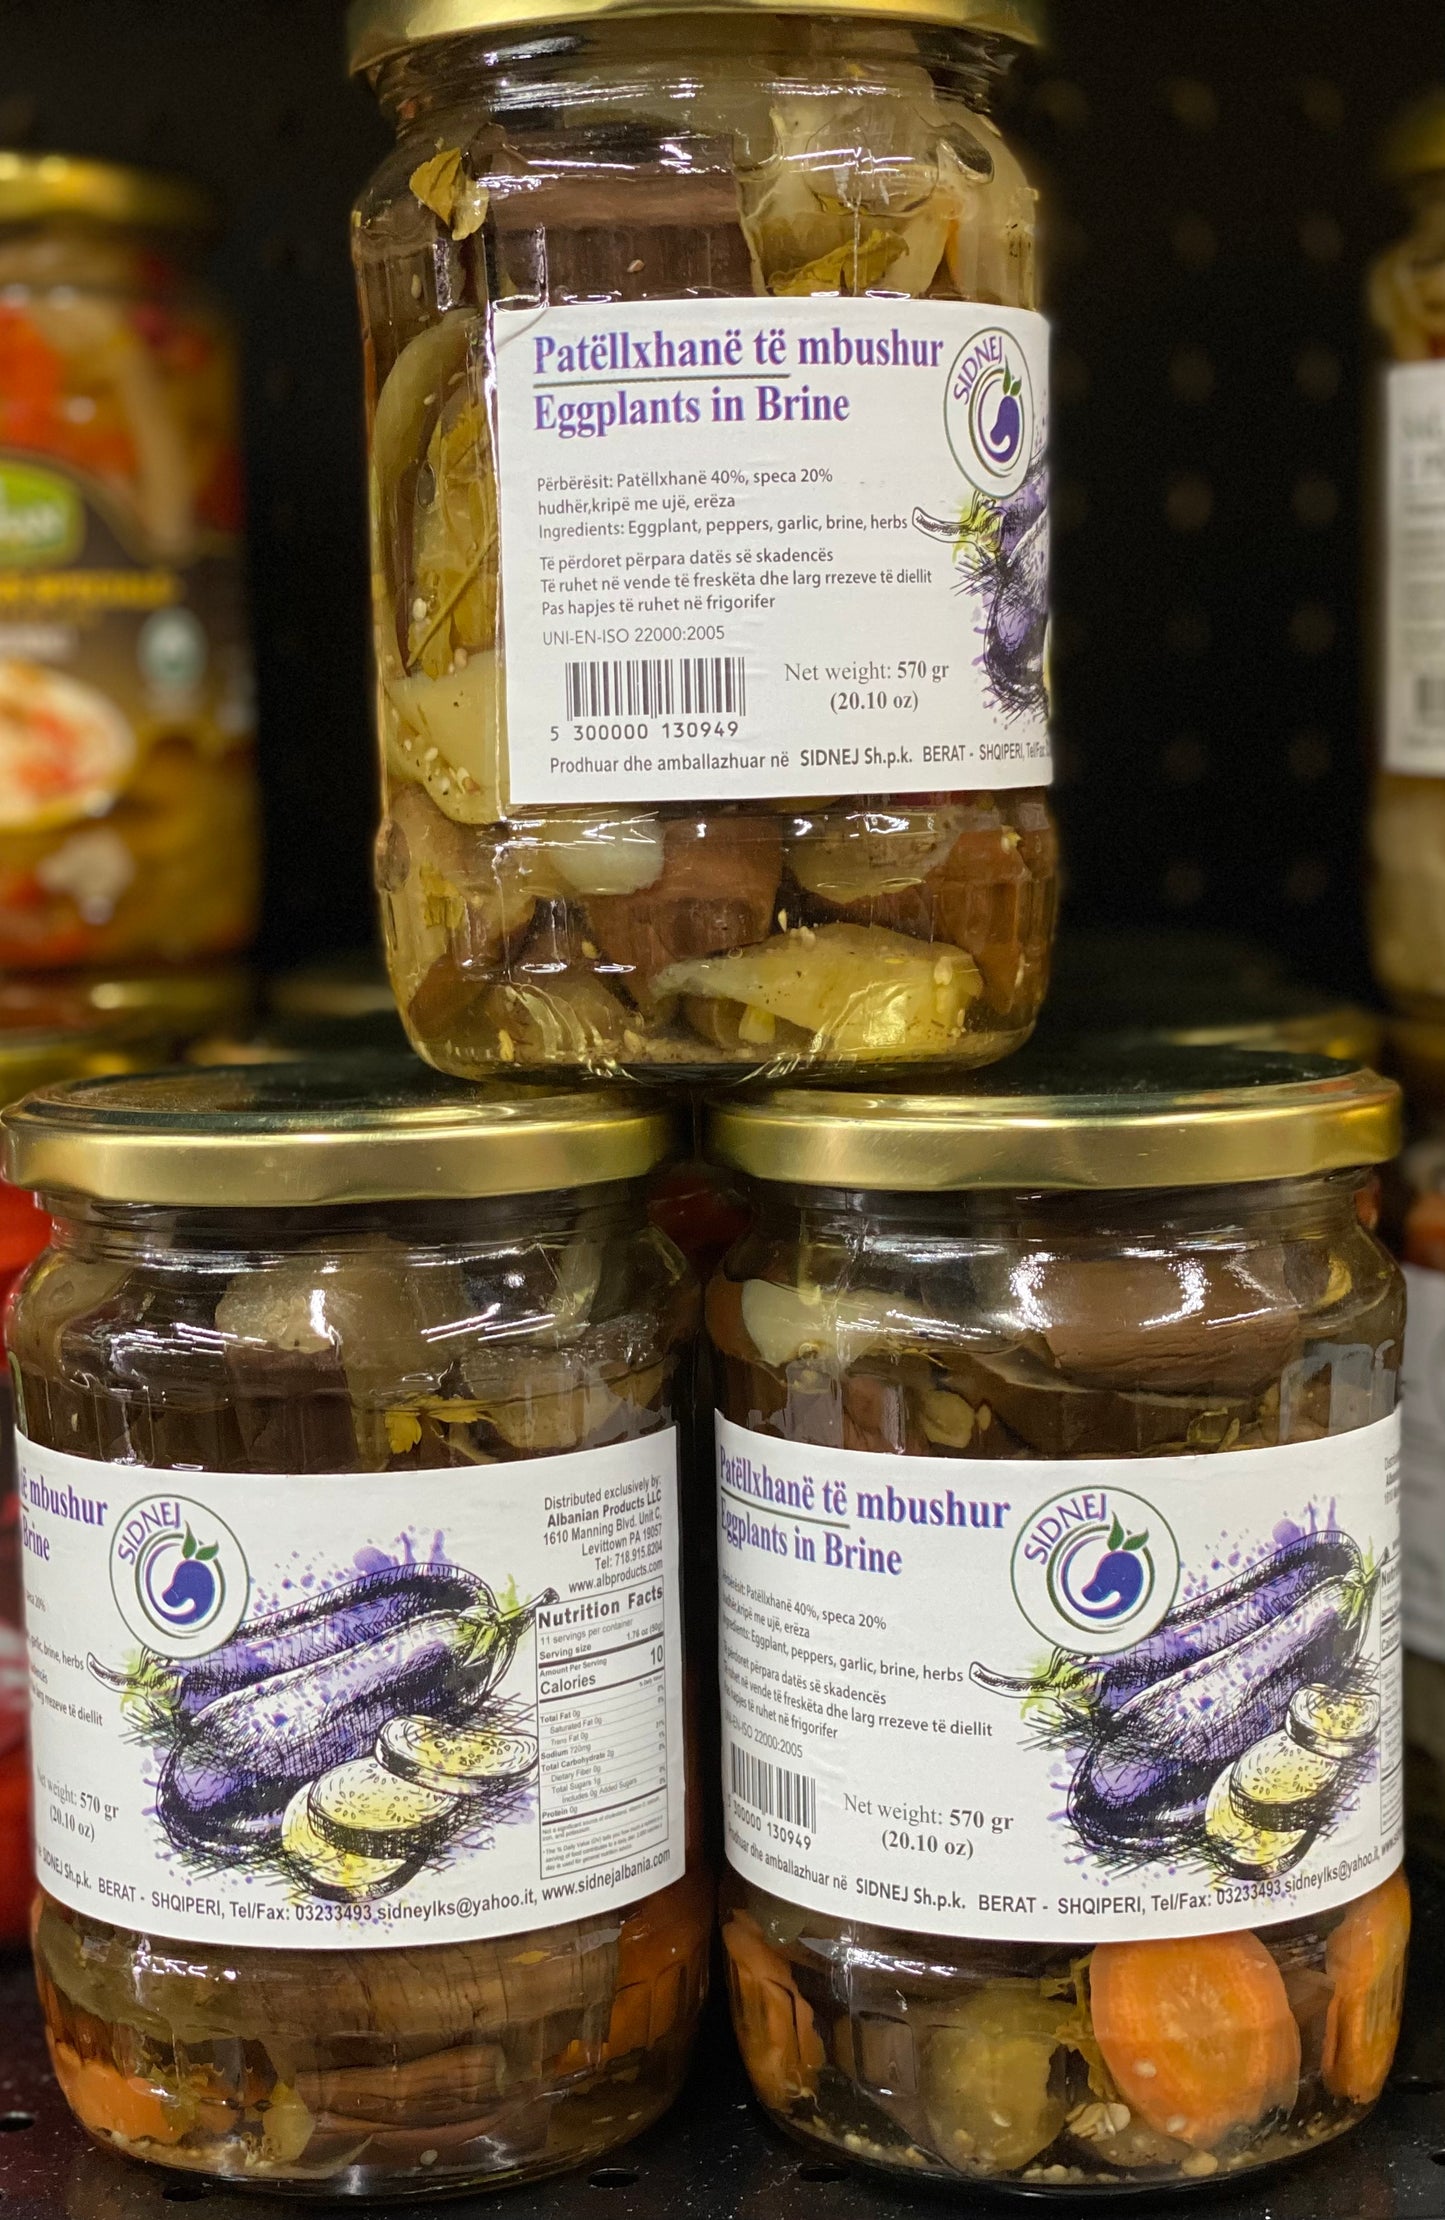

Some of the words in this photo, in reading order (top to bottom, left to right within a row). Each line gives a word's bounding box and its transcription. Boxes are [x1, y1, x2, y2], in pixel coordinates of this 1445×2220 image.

[533, 329, 743, 374] Patëllxhanë
[753, 329, 787, 366] të
[797, 327, 944, 367] mbushur
[953, 335, 1003, 405] SIDNEJ
[533, 390, 700, 439] Eggplants
[711, 386, 745, 422] in
[756, 385, 850, 421] Brine
[537, 474, 614, 492] Përbërësit:
[617, 470, 707, 487] Patëllxhanë
[711, 470, 750, 486] 40%,
[753, 471, 797, 487] speca
[801, 468, 833, 483] 20%
[634, 499, 658, 512] me
[662, 495, 690, 512] ujë,
[694, 494, 736, 508] erëza
[539, 522, 625, 541] Ingredients:
[628, 518, 702, 537] Eggplant,
[706, 519, 773, 536] peppers,
[777, 515, 822, 533] garlic,
[826, 514, 867, 531] brine,
[871, 514, 908, 529] herbs
[540, 556, 555, 570] Të
[558, 554, 622, 573] përdoret
[626, 552, 685, 570] përpara
[689, 550, 732, 565] datës
[736, 550, 752, 563] së
[756, 547, 834, 562] skadencës
[541, 578, 556, 593] Të
[559, 577, 598, 592] ruhet
[602, 576, 620, 591] në
[624, 574, 671, 589] vende
[675, 573, 690, 588] të
[693, 570, 756, 588] freskëta
[760, 570, 789, 585] dhe
[793, 570, 821, 588] larg
[825, 572, 877, 584] rrezeve
[880, 569, 893, 583] të
[897, 568, 932, 584] diellit
[542, 601, 564, 616] Pas
[568, 600, 616, 617] hapjes
[619, 598, 634, 613] të
[638, 597, 680, 612] ruhet
[684, 596, 702, 611] në
[706, 594, 775, 613] frigorifer
[543, 628, 629, 645] UNI-EN-ISO
[635, 625, 725, 642] 22000:2005
[784, 662, 819, 681] Net
[825, 660, 891, 684] weight:
[897, 660, 927, 679] 570
[932, 663, 949, 683] gr
[830, 691, 887, 714] (20.10
[893, 690, 919, 711] oz)
[550, 726, 559, 741] 5
[573, 723, 649, 741] 300000
[662, 721, 739, 739] 130949
[550, 757, 618, 774] Prodhuar
[624, 755, 652, 772] dhe
[657, 752, 765, 772] amballazhuar
[771, 751, 789, 768] në
[800, 747, 859, 767] SIDNEJ
[864, 746, 912, 768] Sh.p.k.
[923, 745, 966, 763] BERAT
[30, 1474, 109, 1526] mbushur
[544, 1487, 601, 1511] Distributed
[604, 1477, 649, 1500] exclusively
[720, 1446, 815, 1511] Patëllxhanë
[822, 1479, 848, 1516] të
[856, 1484, 1012, 1529] mbushur
[547, 1508, 599, 1528] Albanian
[602, 1497, 645, 1518] Products
[647, 1489, 662, 1505] LLC
[118, 1502, 181, 1566] SIDNEJ
[543, 1529, 569, 1546] 1610
[571, 1522, 614, 1541] Manning
[616, 1515, 637, 1532] Blvd.
[639, 1509, 653, 1525] Unit
[720, 1496, 788, 1556] Eggplants
[794, 1524, 817, 1563] in
[824, 1530, 904, 1576] Brine
[1023, 1492, 1107, 1566] SIDNEJ
[581, 1536, 628, 1556] Levittown
[629, 1530, 641, 1545] PA
[568, 1559, 664, 1593] www.albproducts.com
[595, 1555, 613, 1571] Tel:
[538, 1599, 620, 1629] Nutrition
[629, 1585, 664, 1609] Facts
[794, 1601, 820, 1621] 40%,
[822, 1610, 855, 1626] speca
[859, 1613, 887, 1630] 20%
[553, 1629, 587, 1645] servings
[588, 1627, 600, 1639] per
[602, 1618, 634, 1634] container
[754, 1612, 766, 1626] me
[784, 1621, 810, 1639] erëza
[62, 1650, 85, 1670] herbs
[539, 1646, 573, 1661] Serving
[575, 1643, 592, 1655] size
[751, 1629, 789, 1657] Eggplant,
[791, 1645, 837, 1668] peppers,
[840, 1656, 877, 1676] garlic,
[880, 1659, 919, 1681] brine,
[923, 1664, 964, 1682] herbs
[539, 1664, 569, 1677] Amount
[569, 1661, 582, 1672] Per
[583, 1657, 608, 1671] Serving
[540, 1673, 597, 1696] Calories
[650, 1644, 664, 1666] 10
[781, 1670, 808, 1690] datës
[809, 1678, 821, 1693] së
[823, 1681, 887, 1705] skadencës
[77, 1706, 104, 1727] diellit
[540, 1715, 559, 1724] Total
[560, 1711, 572, 1721] Fat
[778, 1711, 790, 1727] në
[791, 1714, 838, 1739] frigorifer
[783, 1690, 824, 1715] freskëta
[826, 1702, 849, 1720] dhe
[851, 1706, 875, 1728] larg
[879, 1715, 929, 1732] rrezeve
[932, 1719, 947, 1733] të
[950, 1720, 993, 1737] diellit
[541, 1749, 569, 1760] Sodium
[754, 1728, 803, 1759] 22000:2005
[541, 1763, 560, 1773] Total
[561, 1751, 606, 1768] Carbohydrate
[79, 1791, 101, 1814] 570
[104, 1804, 119, 1822] gr
[541, 1808, 569, 1819] Protein
[843, 1792, 873, 1815] Net
[878, 1802, 943, 1827] weight:
[949, 1808, 985, 1828] 570
[991, 1815, 1014, 1835] gr
[78, 1820, 95, 1843] oz)
[766, 1822, 812, 1850] 130949
[881, 1829, 938, 1853] (20.10
[944, 1838, 974, 1861] oz)
[98, 1877, 136, 1903] BERAT
[151, 1891, 226, 1919] SHQIPERI,
[229, 1901, 290, 1920] Tel/Fax:
[296, 1903, 372, 1921] 03233493
[377, 1892, 538, 1923] sidneylks@yahoo.it,
[541, 1848, 671, 1902] www.sidnejalbania.com
[765, 1854, 831, 1887] amballazhuar
[833, 1874, 848, 1891] në
[856, 1877, 909, 1902] SIDNEJ
[913, 1887, 966, 1911] Sh.p.k.
[978, 1894, 1037, 1914] BERAT
[1057, 1896, 1146, 1916] SHQIPERI,
[1151, 1892, 1212, 1912] Tel/Fax:
[1216, 1878, 1281, 1906] 03233493
